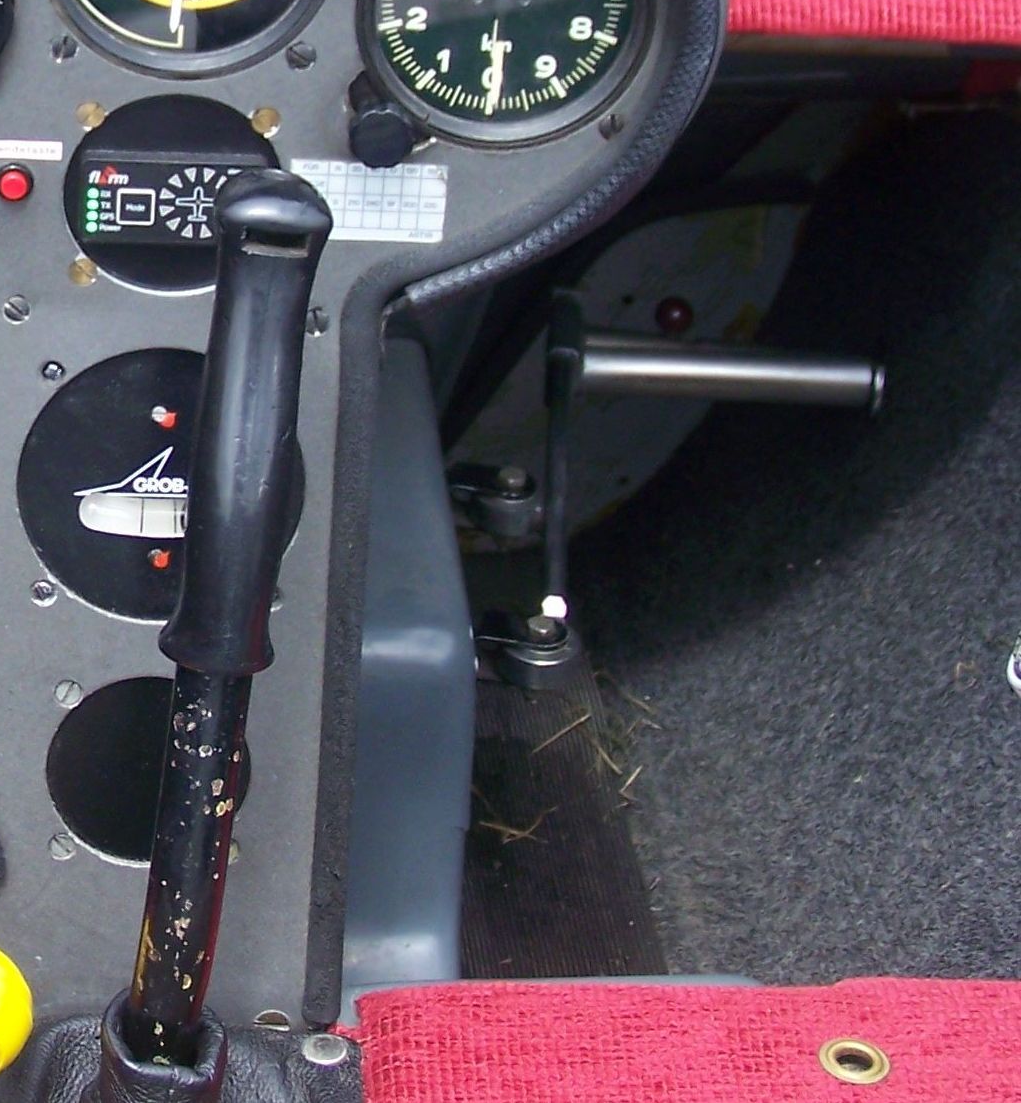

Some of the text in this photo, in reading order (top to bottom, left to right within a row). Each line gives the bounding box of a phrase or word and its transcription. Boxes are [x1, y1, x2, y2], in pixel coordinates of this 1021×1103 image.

[405, 7, 427, 31] 2
[568, 16, 593, 40] 8
[436, 49, 451, 73] 1
[535, 55, 557, 78] 9
